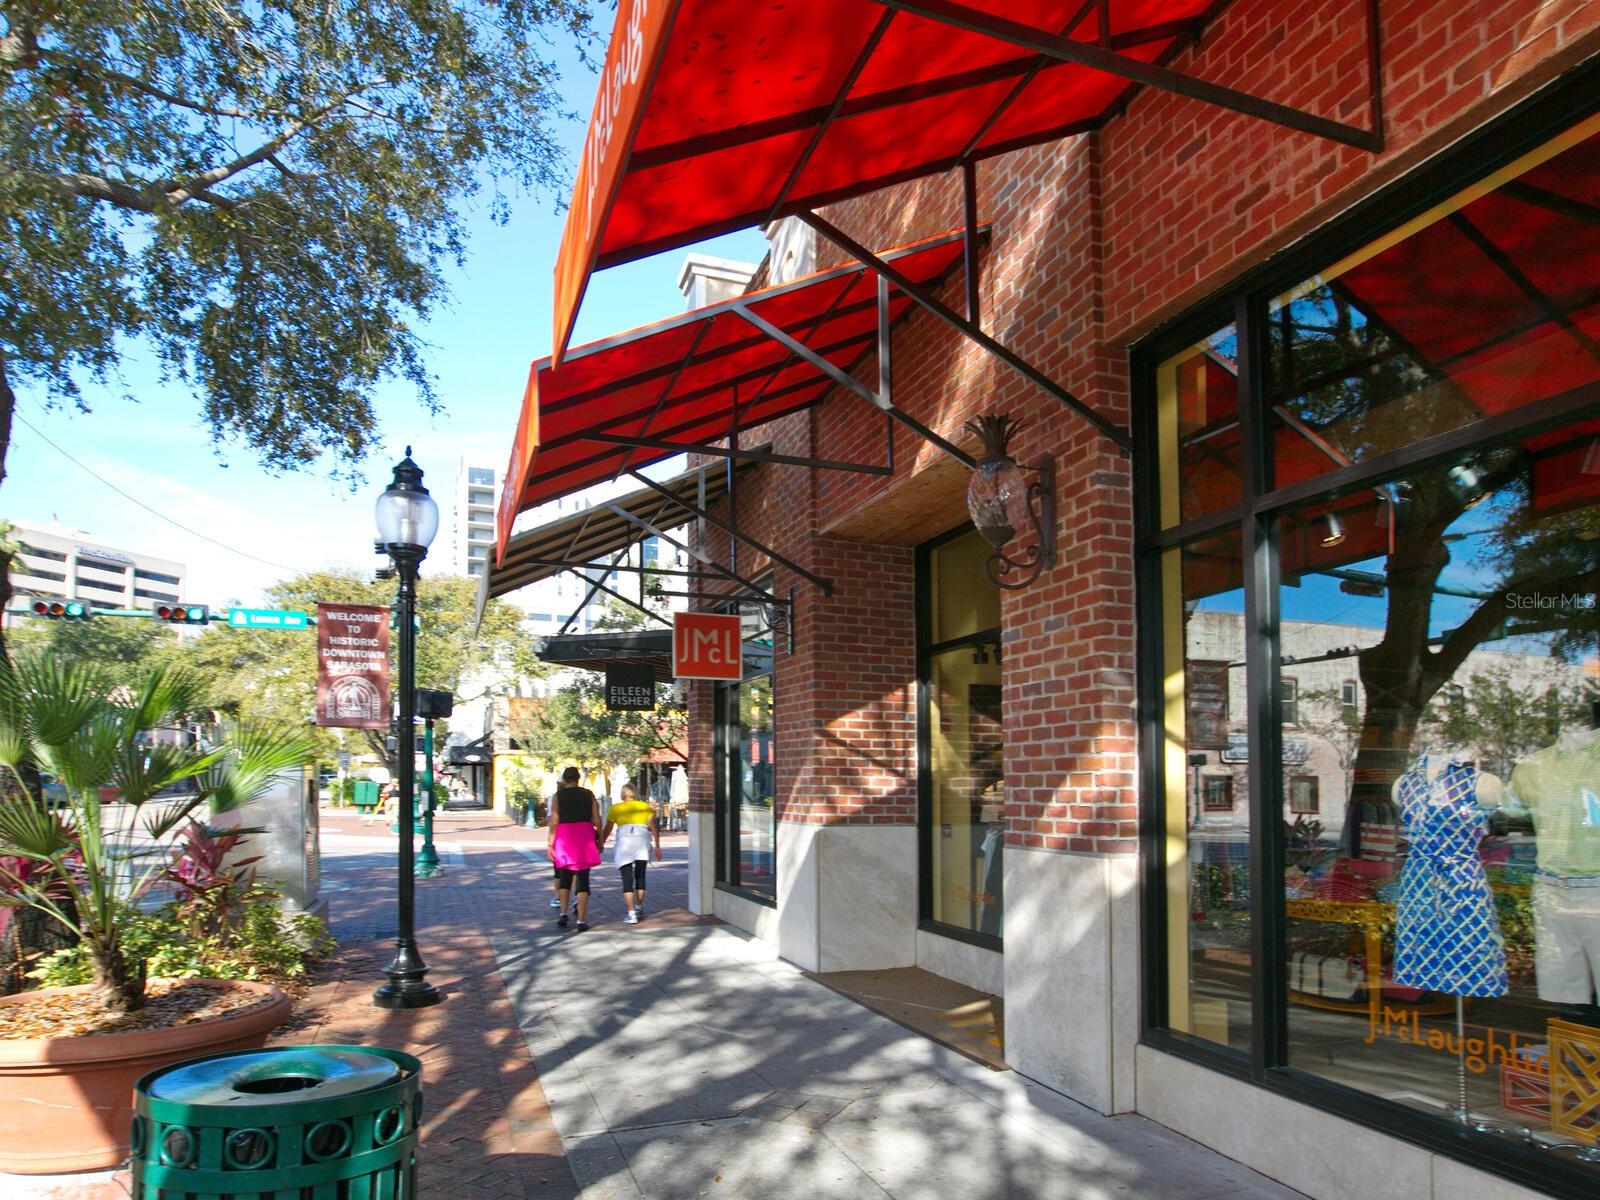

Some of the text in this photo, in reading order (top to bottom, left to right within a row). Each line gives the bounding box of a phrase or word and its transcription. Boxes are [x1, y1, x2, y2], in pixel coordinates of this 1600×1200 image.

[326, 611, 381, 622] WELCOME
[347, 625, 361, 633] TO
[329, 636, 379, 647] HISTORIC
[323, 648, 385, 659] DOWNTOWN
[326, 660, 381, 671] SARASOTA
[610, 686, 651, 697] EILEEN
[610, 696, 651, 706] FISHER
